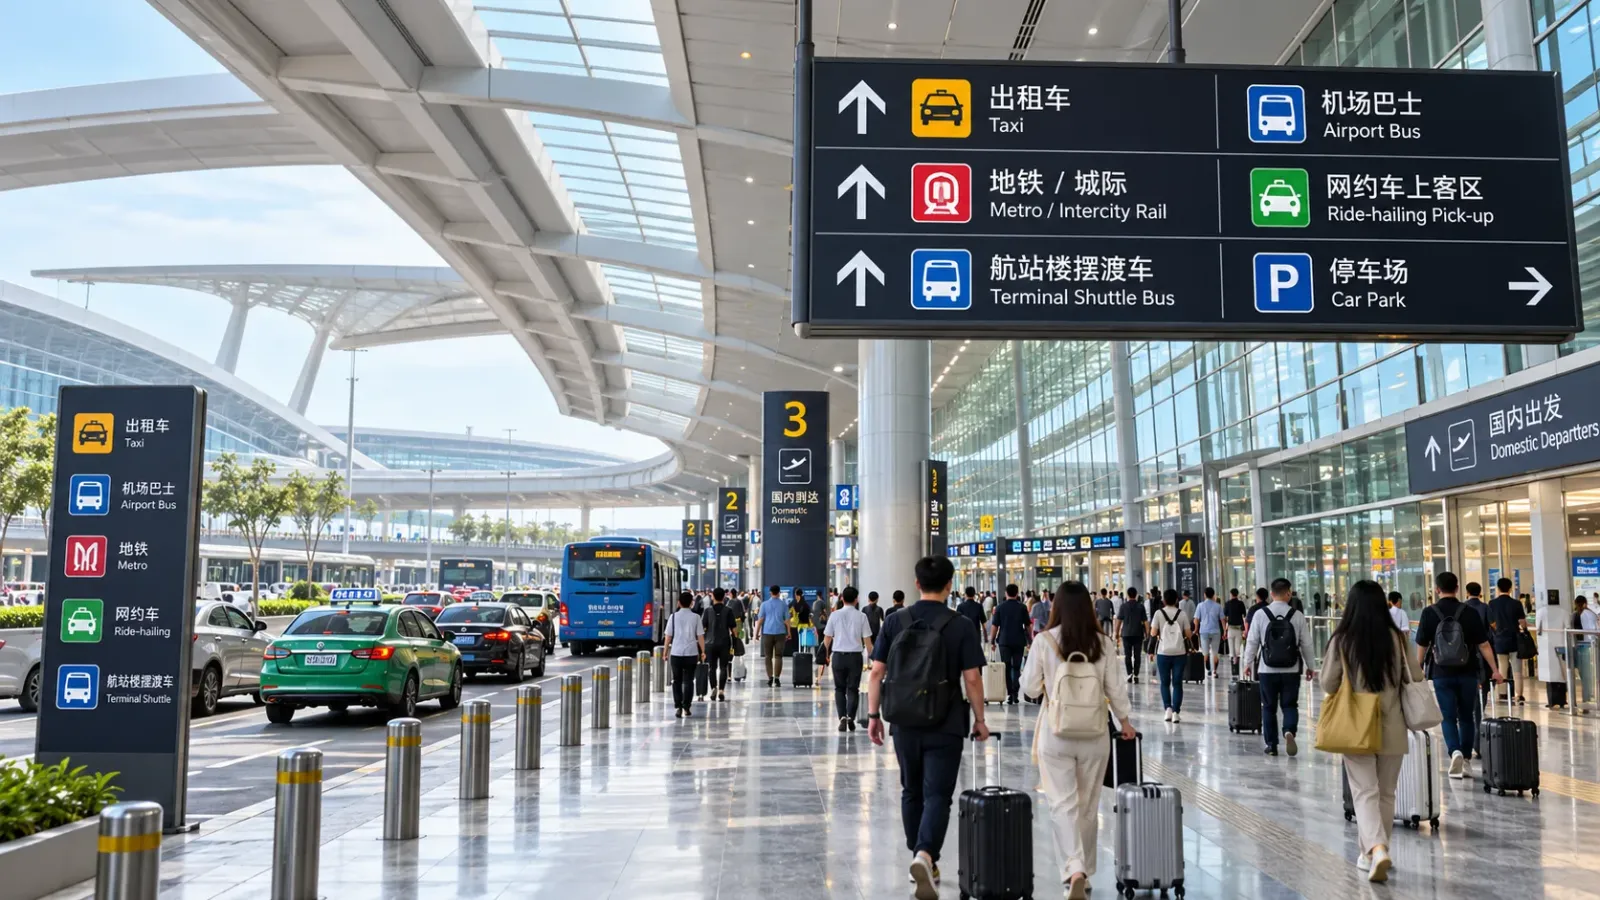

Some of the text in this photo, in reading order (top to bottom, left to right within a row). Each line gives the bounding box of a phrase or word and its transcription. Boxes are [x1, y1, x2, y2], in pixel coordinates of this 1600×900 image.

[991, 84, 1070, 111] 出租车
[1322, 90, 1421, 115] 机场巴士
[989, 118, 1023, 132] Taxi
[1324, 123, 1420, 141] Airport Bus
[990, 169, 1127, 196] 地铁 / 城际
[1327, 174, 1483, 200] 网约车上客区
[991, 202, 1166, 222] Metro / Intercity Rail
[1328, 206, 1493, 226] Ride-hailing Pick-up
[990, 254, 1153, 282] 航站楼摆渡车
[1330, 258, 1407, 284] 停车场
[990, 289, 1174, 305] Terminal Shuttle Bus
[1332, 292, 1406, 307] Car Park
[783, 400, 808, 438] 3
[1489, 393, 1563, 437] 国内出发
[126, 418, 169, 432] 出租车
[125, 438, 144, 447] Taxi
[1490, 435, 1538, 460] Domestic
[122, 482, 175, 495] 机场巴士
[121, 500, 176, 511] Airport Bus
[726, 492, 737, 509] 2
[687, 523, 695, 535] 2
[119, 542, 147, 556] 地铁
[1180, 540, 1192, 558] 4
[118, 561, 147, 570] Metro
[116, 607, 159, 621] 网约车
[115, 627, 170, 638] Ride-hailing
[107, 694, 141, 703] Terminal
